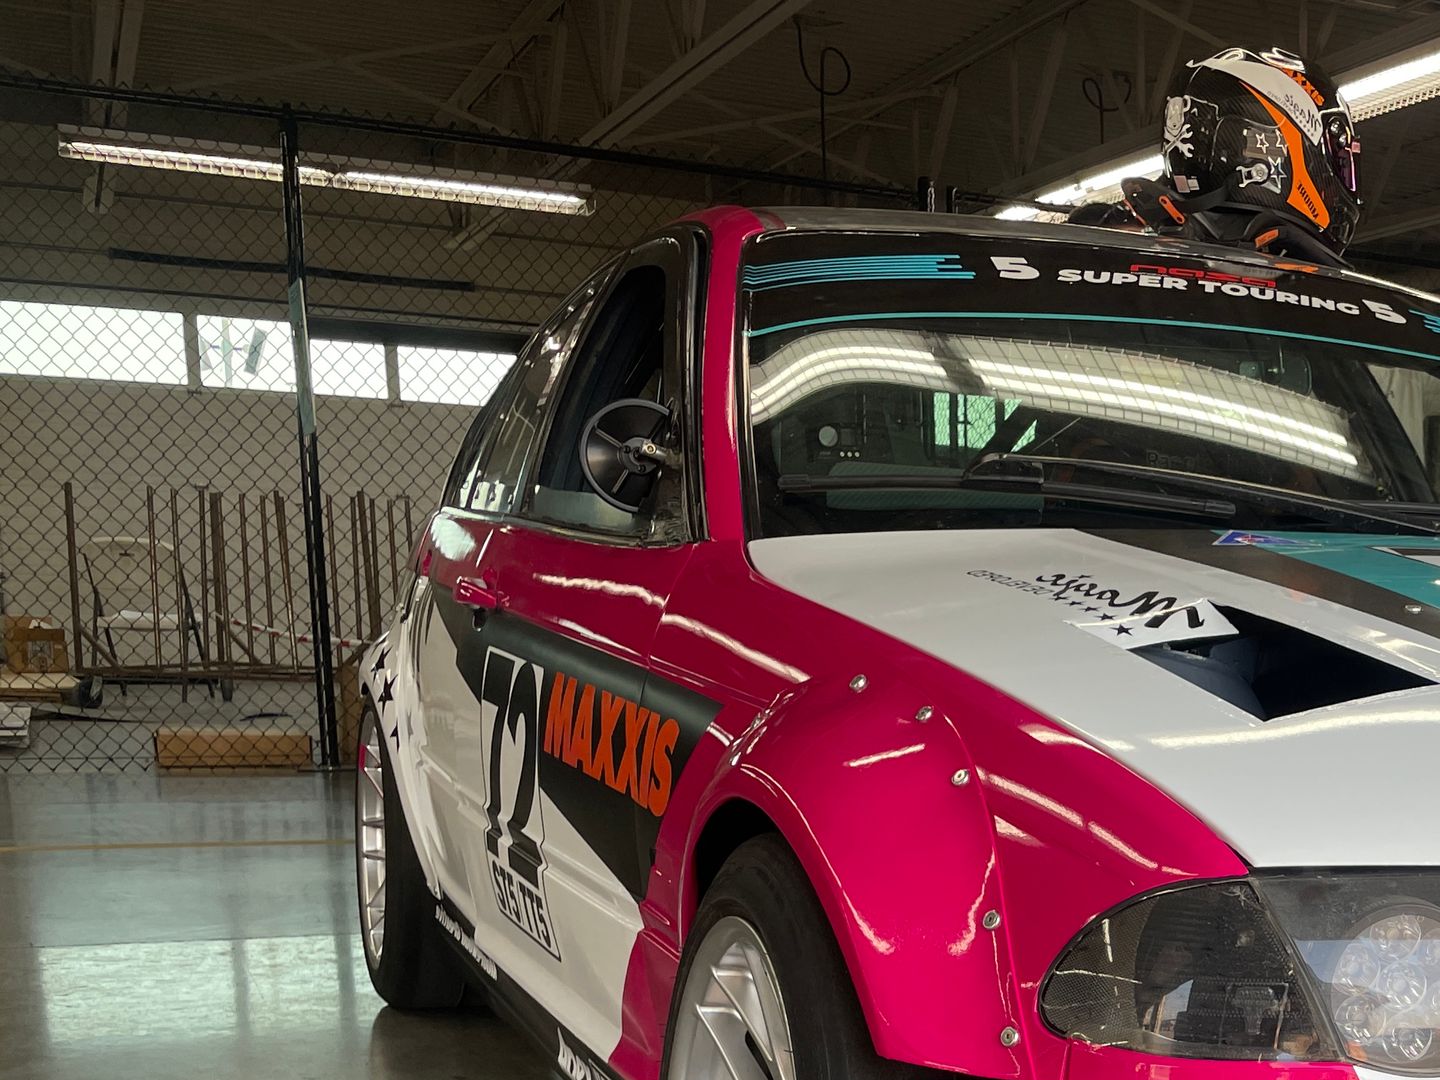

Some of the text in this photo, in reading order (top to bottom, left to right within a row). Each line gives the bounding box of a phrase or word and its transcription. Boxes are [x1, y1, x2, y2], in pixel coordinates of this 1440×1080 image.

[990, 256, 1040, 280] 5
[1057, 269, 1361, 315] SUPER TOURING
[1362, 299, 1407, 324] 5
[544, 672, 681, 816] MAXXIS
[482, 650, 543, 890] 72
